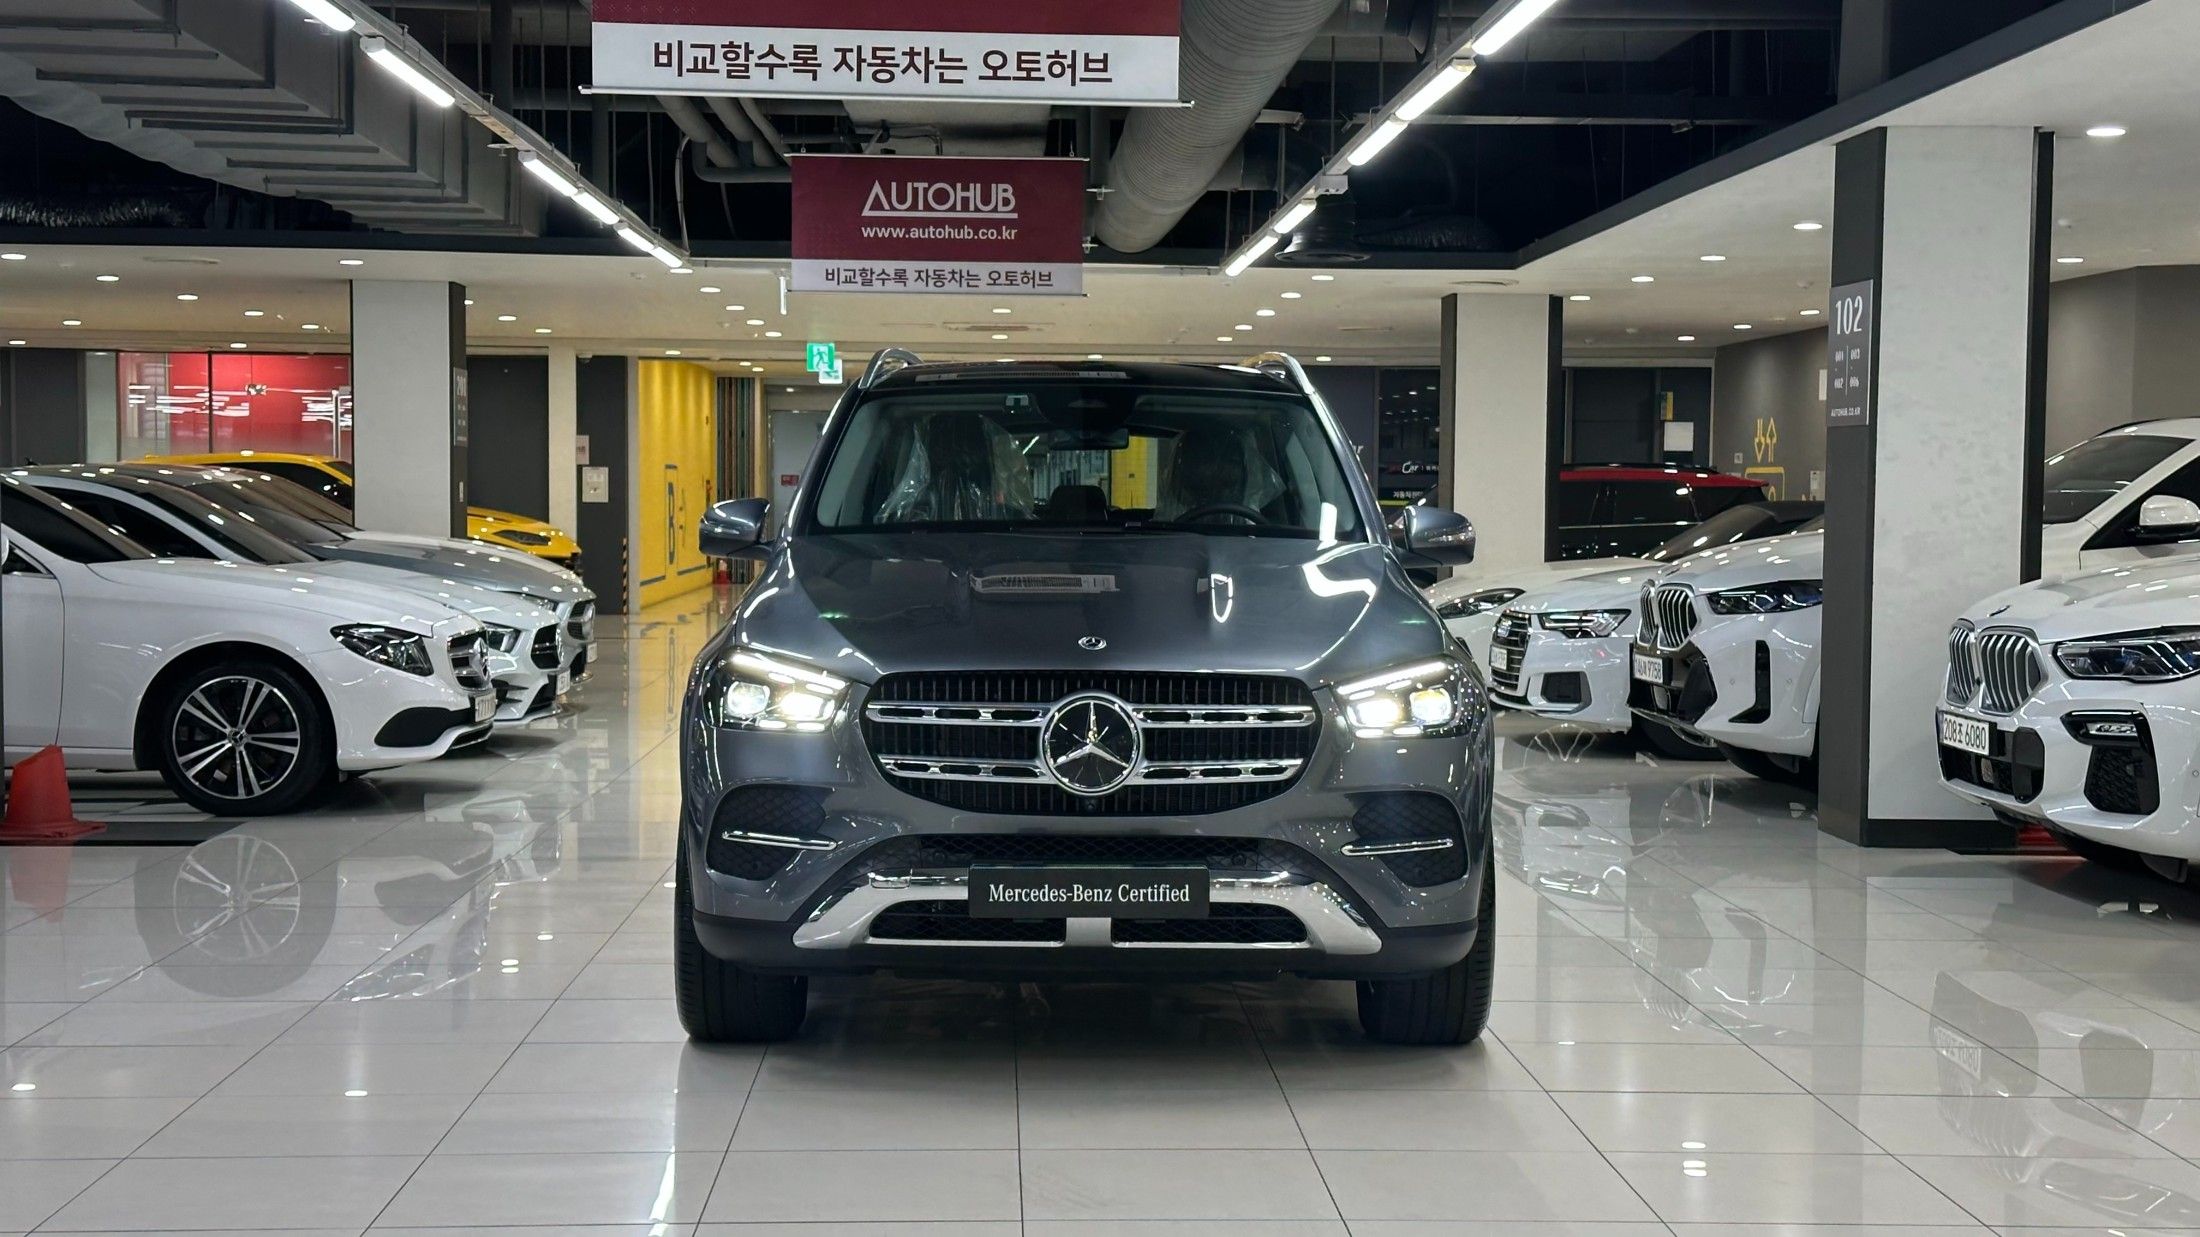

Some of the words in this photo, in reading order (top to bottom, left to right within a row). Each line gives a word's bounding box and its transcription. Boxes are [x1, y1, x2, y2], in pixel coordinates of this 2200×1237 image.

[653, 39, 823, 82] 비교할수록
[832, 44, 968, 84] 자동차는
[978, 49, 1113, 87] 오토허브
[861, 179, 1018, 219] AUTOHUB
[861, 224, 1018, 241] www.autohub.co.kr
[825, 266, 909, 287] 비교할수록
[914, 268, 982, 288] 자동차는
[985, 270, 1054, 289] 오토허브
[1835, 295, 1863, 335] 102
[1943, 717, 1964, 744] 208조
[1964, 723, 1987, 750] 6080
[988, 883, 1113, 903] Mercedes-Benz
[1117, 883, 1190, 903] Certified
